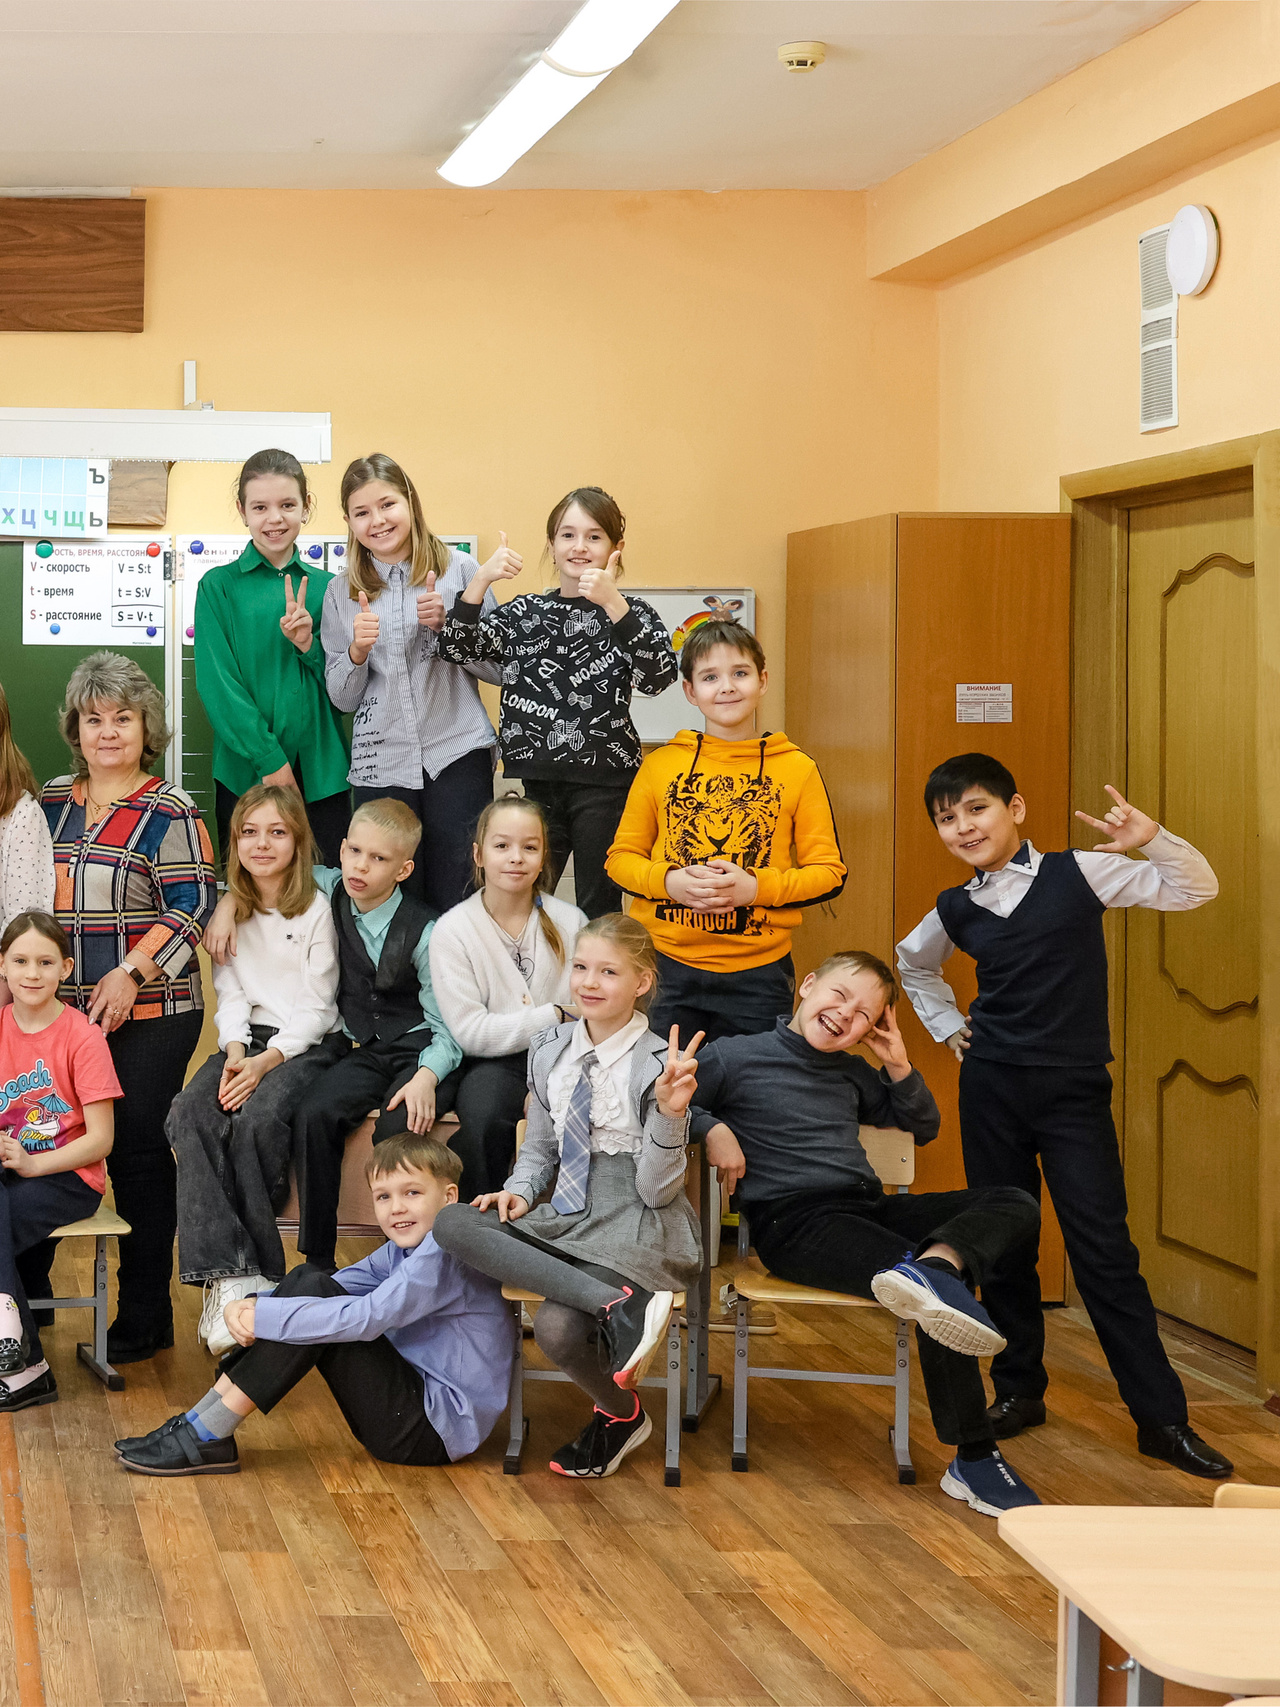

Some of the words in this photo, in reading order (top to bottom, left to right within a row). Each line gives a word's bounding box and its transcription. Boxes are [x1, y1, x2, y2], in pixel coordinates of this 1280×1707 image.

[78, 549, 105, 557] ВРЕМЯ,
[107, 549, 148, 557] РАССТОЯН
[46, 563, 91, 575] скорость
[44, 588, 74, 598] время
[46, 611, 102, 622] расстояние
[569, 646, 623, 688] LONDON
[502, 690, 559, 720] LONDON
[663, 908, 737, 931] THROUGH
